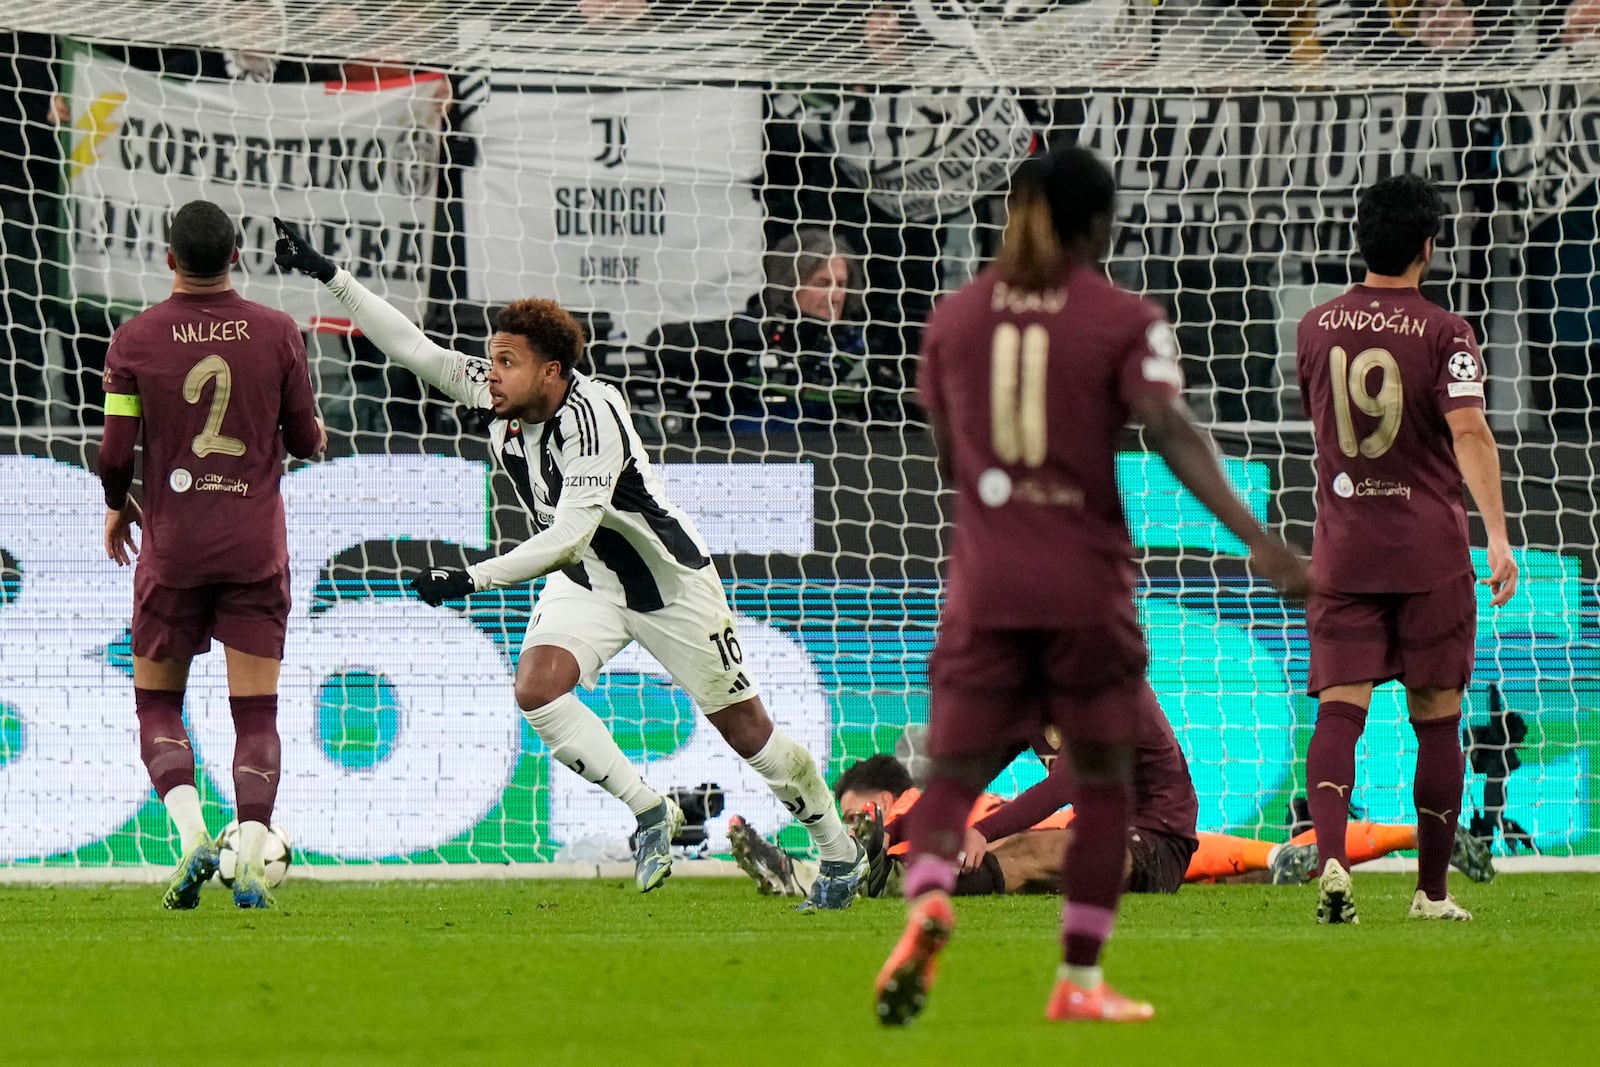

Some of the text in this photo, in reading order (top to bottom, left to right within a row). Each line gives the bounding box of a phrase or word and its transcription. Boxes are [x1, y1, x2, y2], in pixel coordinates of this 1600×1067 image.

[119, 116, 388, 192] COPERTINO
[938, 128, 1000, 181] CLUB
[1076, 92, 1457, 190] ALTAMURA
[555, 187, 666, 236] SENAGO
[172, 319, 250, 343] WALKER
[1318, 304, 1428, 337] GÜNDOĞAN
[182, 354, 247, 459] 2
[991, 322, 1050, 468] 11
[1329, 345, 1404, 459] 19
[195, 477, 249, 497] Community
[204, 473, 224, 484] City
[709, 626, 743, 672] 16
